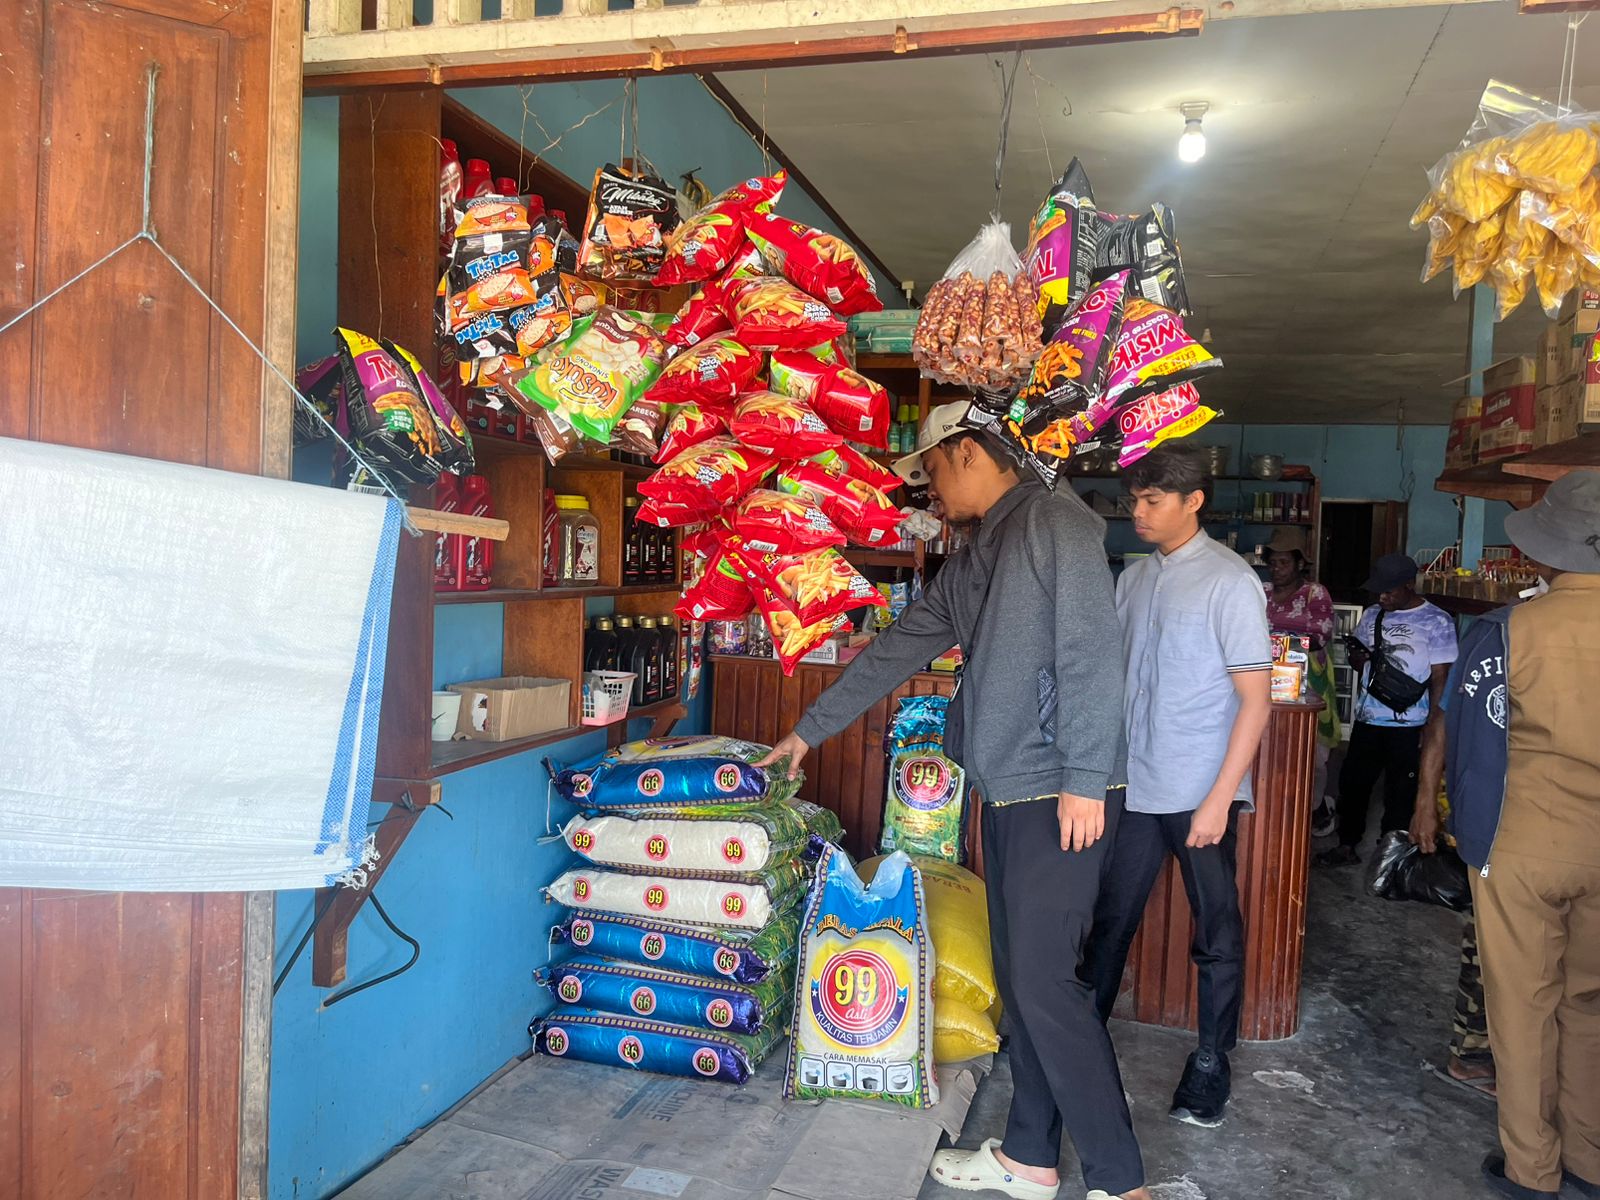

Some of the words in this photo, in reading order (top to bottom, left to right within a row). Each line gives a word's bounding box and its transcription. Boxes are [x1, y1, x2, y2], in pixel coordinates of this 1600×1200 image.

[575, 355, 609, 379] SINGKONG
[911, 762, 939, 788] 99
[575, 833, 590, 848] 99
[650, 840, 665, 854] 99
[726, 843, 742, 857] 99
[648, 890, 664, 904] 99
[725, 897, 742, 912] 99
[816, 913, 859, 938] BERAS
[834, 964, 880, 1006] 99
[845, 1008, 868, 1021] Asli
[815, 1011, 853, 1043] KUALITAS
[854, 1018, 898, 1045] TERJAMIN
[823, 1053, 845, 1062] CARA
[846, 1055, 887, 1065] MEMASAK
